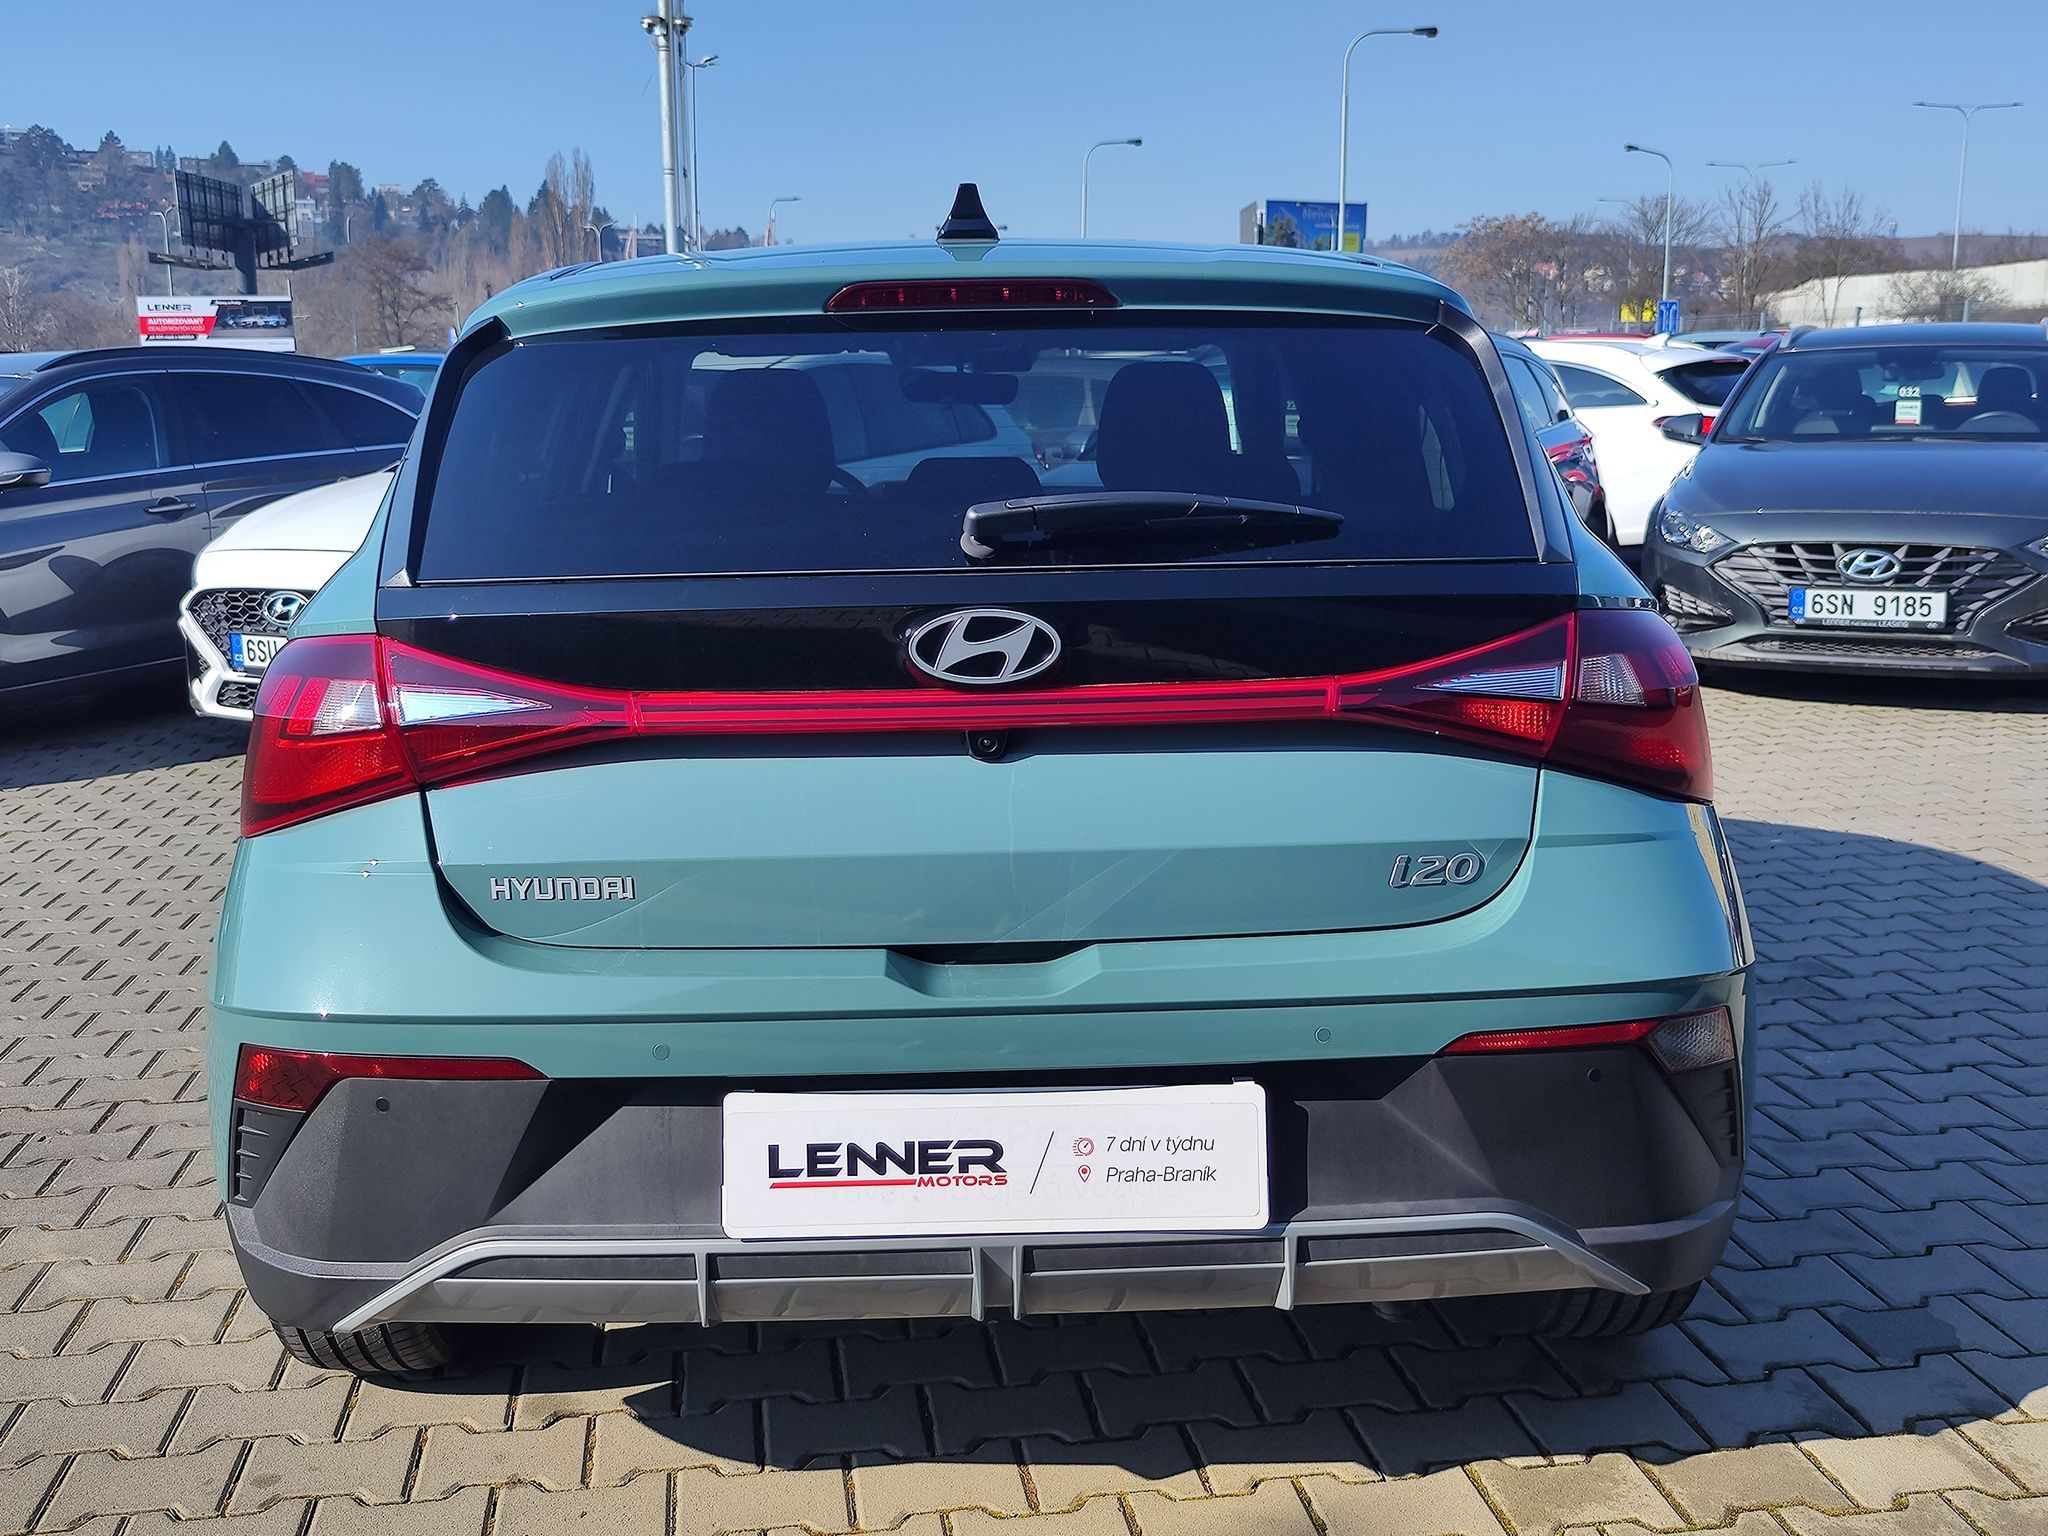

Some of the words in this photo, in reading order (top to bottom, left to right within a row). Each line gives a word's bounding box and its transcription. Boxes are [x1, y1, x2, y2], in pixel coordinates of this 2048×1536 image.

[147, 304, 193, 312] LENNER
[1791, 606, 1804, 615] CZ
[1811, 594, 1854, 615] 6SN
[1874, 596, 1933, 617] 9185
[1388, 852, 1485, 889] i20
[489, 876, 637, 901] HYUNDAI
[1106, 1136, 1116, 1152] 7
[1119, 1135, 1148, 1152] dní
[1150, 1139, 1161, 1151] v
[1165, 1135, 1215, 1155] týdnu
[767, 1139, 1008, 1179] LENNER
[916, 1175, 1008, 1188] MOTORS
[1106, 1165, 1217, 1183] Praha-Braník
